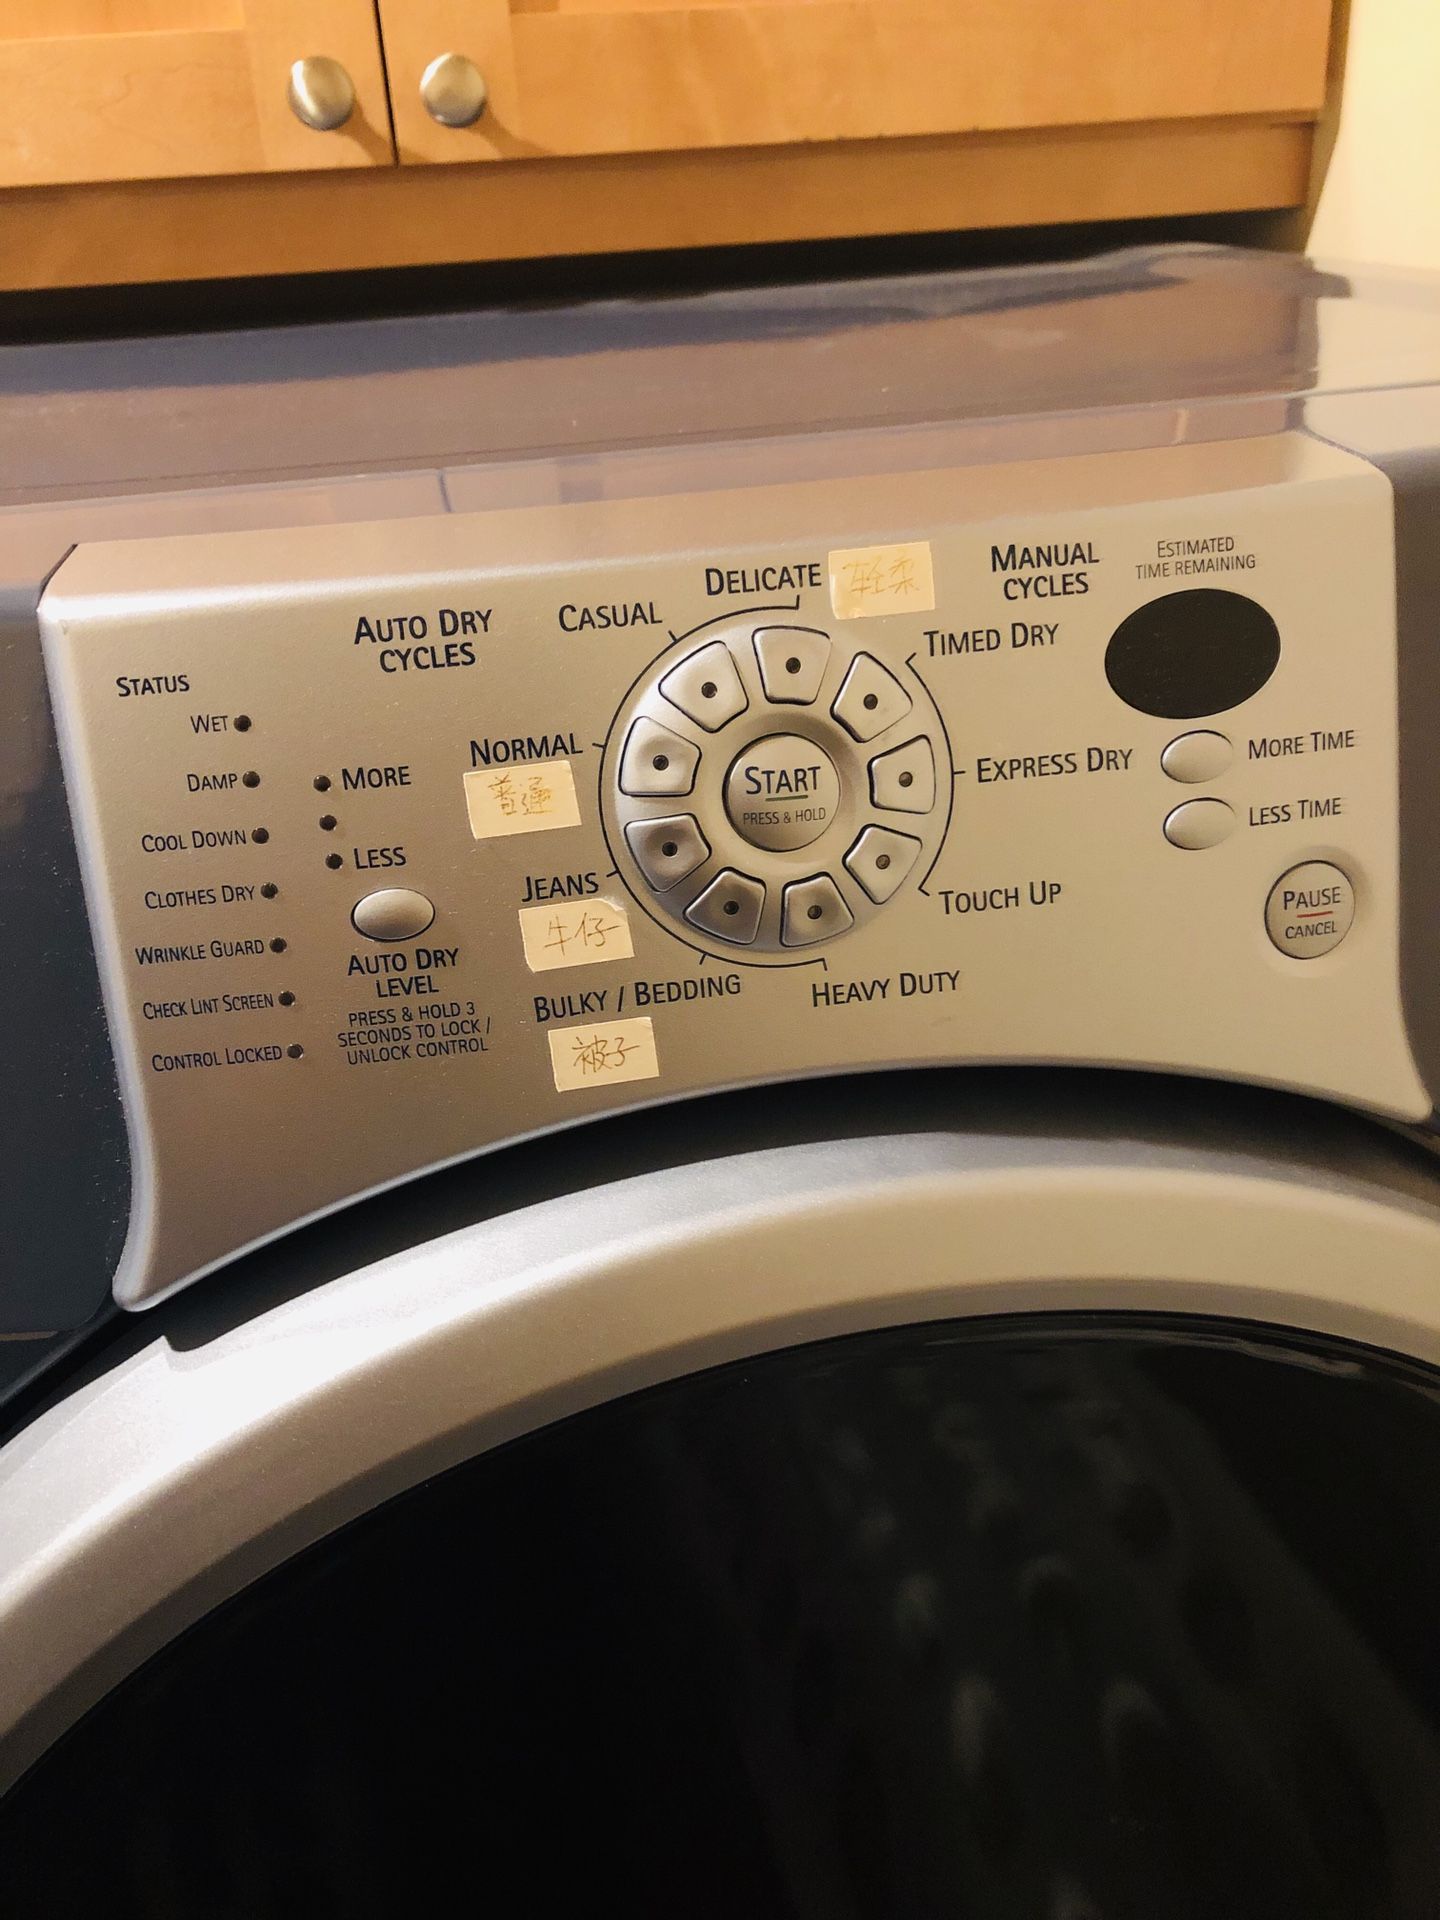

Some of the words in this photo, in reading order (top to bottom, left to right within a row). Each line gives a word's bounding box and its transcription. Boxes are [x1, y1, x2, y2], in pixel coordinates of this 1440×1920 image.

[990, 541, 1100, 572] MANUAL
[1156, 536, 1235, 558] ESTIMATED
[705, 562, 822, 596] DELICATE
[1135, 562, 1170, 580] TIME
[1175, 553, 1256, 576] REMAINING
[1003, 571, 1090, 601] CYCLES
[353, 614, 428, 645] AUTO
[439, 608, 493, 636] DRY
[558, 602, 663, 632] CASUAL
[923, 628, 1001, 657] TIMED
[1010, 622, 1060, 649] DRY
[379, 642, 477, 673] CYCLES
[115, 674, 191, 697] STATUS
[190, 714, 229, 733] WET
[469, 732, 584, 767] NORMAL
[1247, 735, 1305, 760] MORE
[1310, 729, 1356, 750] TIME
[341, 765, 412, 791] MORE
[976, 752, 1078, 783] EXPRESS
[1086, 746, 1134, 771] DRY
[186, 772, 238, 793] DAMP
[744, 766, 822, 795] START
[742, 811, 780, 826] PRESS
[783, 812, 791, 824] &
[795, 807, 827, 823] HOLD
[1248, 803, 1292, 828] LESS
[1297, 797, 1342, 820] TIME
[140, 833, 188, 854] COOL
[192, 829, 247, 850] DOWN
[353, 846, 407, 871] LESS
[144, 890, 217, 911] CLOTHES
[221, 885, 256, 904] DRY
[521, 872, 600, 903] JEANS
[938, 886, 1020, 915] TOUCH
[1028, 880, 1063, 906] UP
[1282, 886, 1342, 911] PAUSE
[543, 910, 620, 956] 牛仔
[1284, 920, 1338, 940] CANCEL
[135, 944, 206, 966] WRINKLE
[210, 938, 265, 959] GUARD
[347, 952, 408, 977] AUTO
[415, 947, 460, 970] DRY
[375, 973, 440, 999] LEVEL
[533, 995, 608, 1023] BULKY
[616, 986, 625, 1012] /
[633, 973, 742, 1007] BEDDING
[811, 979, 890, 1008] HEAVY
[900, 970, 961, 998] DUTY
[142, 1001, 188, 1021] CHECK
[191, 999, 222, 1014] LINT
[222, 992, 275, 1012] SCREEN
[348, 1009, 397, 1026] PRESS
[402, 1009, 414, 1022] &
[417, 1004, 460, 1021] HOLD
[465, 1001, 476, 1017] 3
[337, 1027, 413, 1048] SECONDS
[415, 1024, 438, 1040] TO
[440, 1019, 482, 1037] LOCK
[485, 1015, 494, 1035] /
[151, 1050, 222, 1073] CONTROL
[224, 1043, 283, 1064] LOCKED
[346, 1046, 411, 1067] UNLOCK
[416, 1038, 489, 1058] CONTROL
[572, 1035, 640, 1075] 被子
